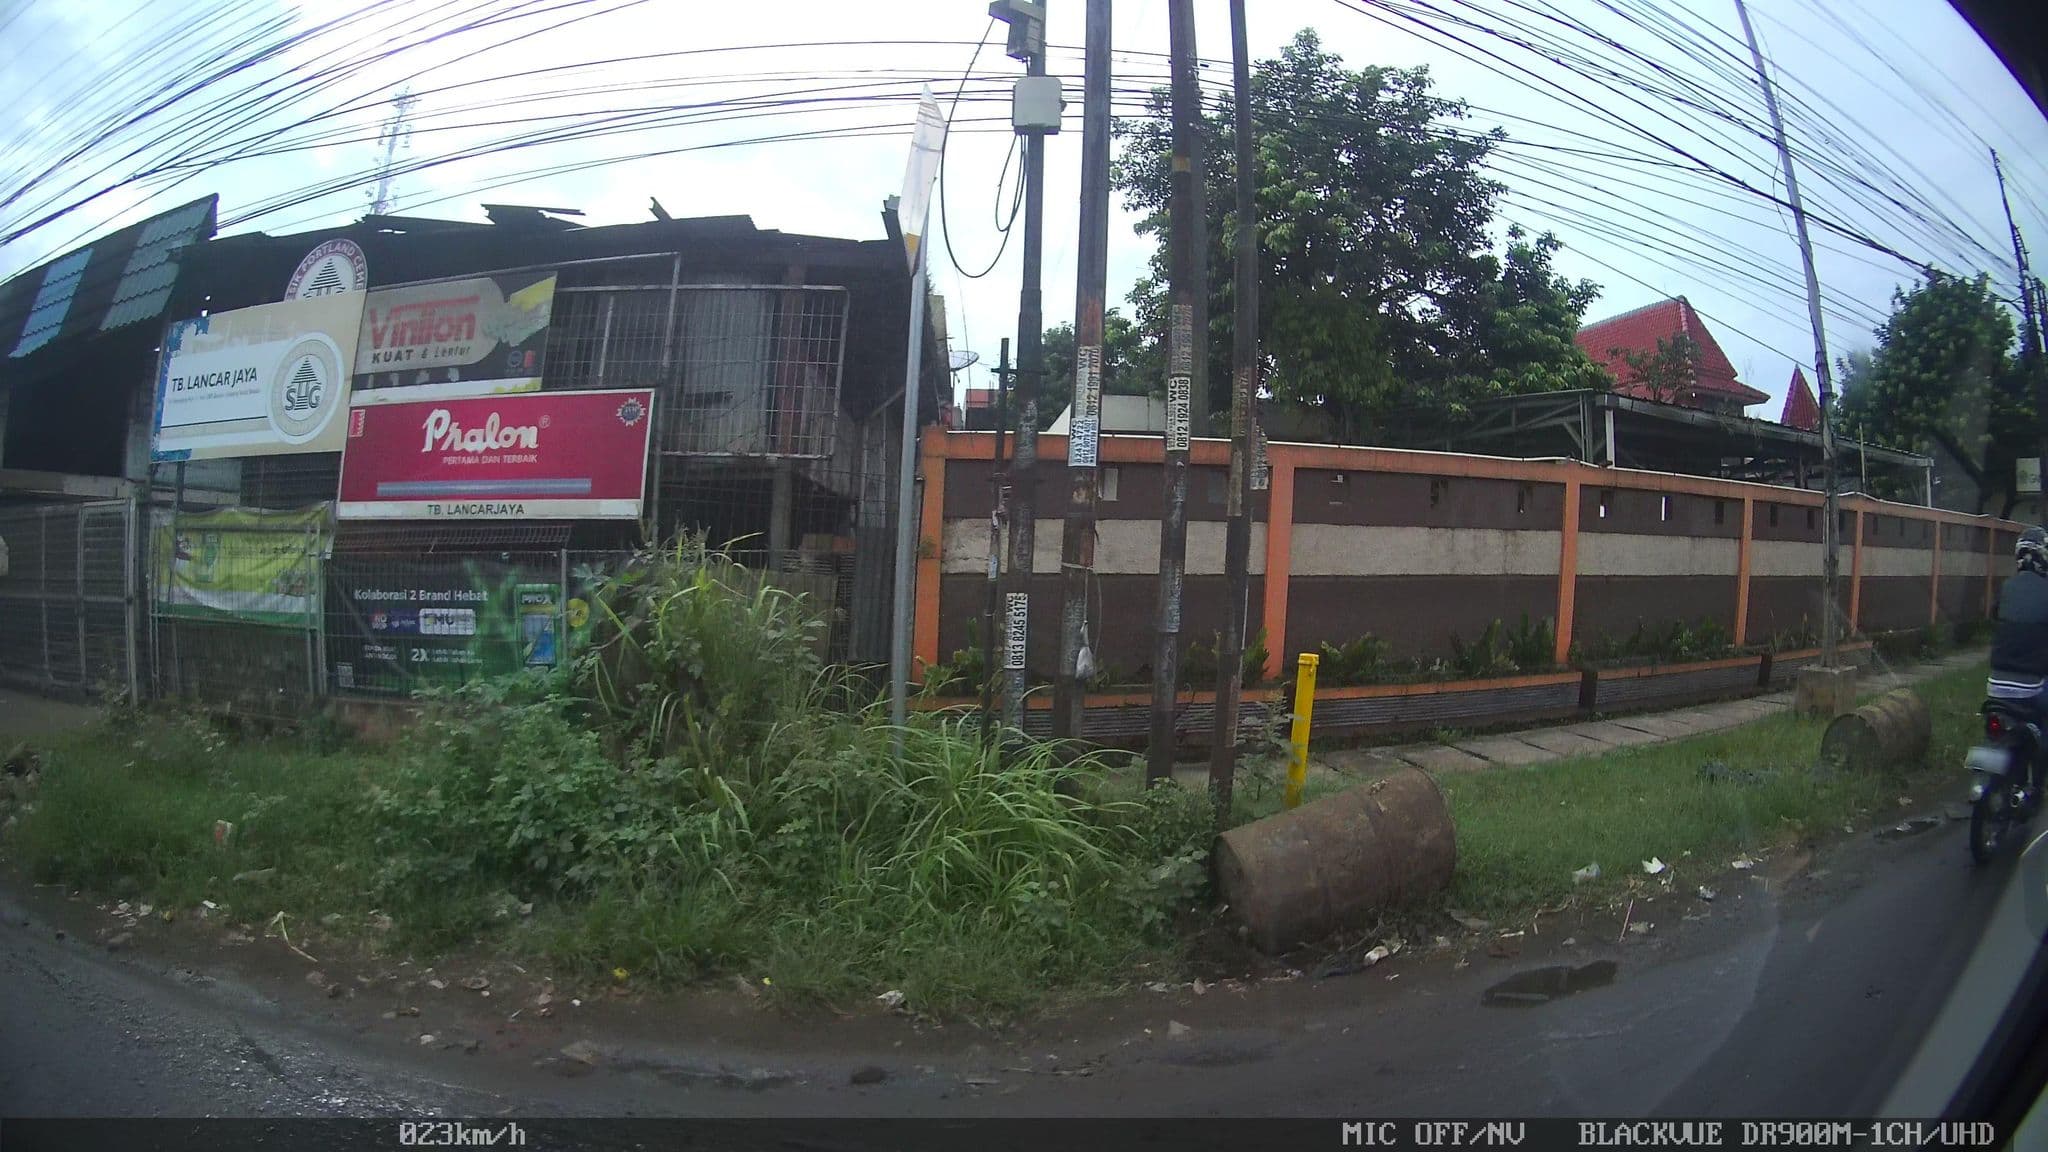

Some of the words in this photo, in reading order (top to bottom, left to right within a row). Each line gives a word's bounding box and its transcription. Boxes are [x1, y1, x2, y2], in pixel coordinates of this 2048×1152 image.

[302, 242, 355, 272] PORTLAND
[369, 296, 481, 350] Vinilon
[371, 349, 413, 364] KUAT
[1078, 348, 1088, 369] WC
[171, 377, 186, 392] TB.
[187, 371, 231, 390] LANCAR
[231, 367, 257, 388] JAYA
[1178, 379, 1189, 401] 0838
[1169, 379, 1177, 402] WC
[1086, 395, 1098, 416] 0812
[1177, 403, 1188, 424] 1924
[421, 408, 540, 454] Pralon
[1071, 420, 1077, 440] WC
[1177, 426, 1188, 448] 0812
[443, 455, 480, 465] PERTAMA
[481, 455, 501, 464] DAN
[503, 454, 539, 464] TERBAIK
[427, 504, 444, 515] TB.
[447, 503, 525, 515] LANCARJAYA
[354, 588, 408, 601] Kolaborasi
[410, 590, 417, 601] 2
[419, 589, 451, 601] Brand
[453, 590, 488, 601] Hebat
[1012, 620, 1025, 641] 8245
[1011, 644, 1024, 666] 0813
